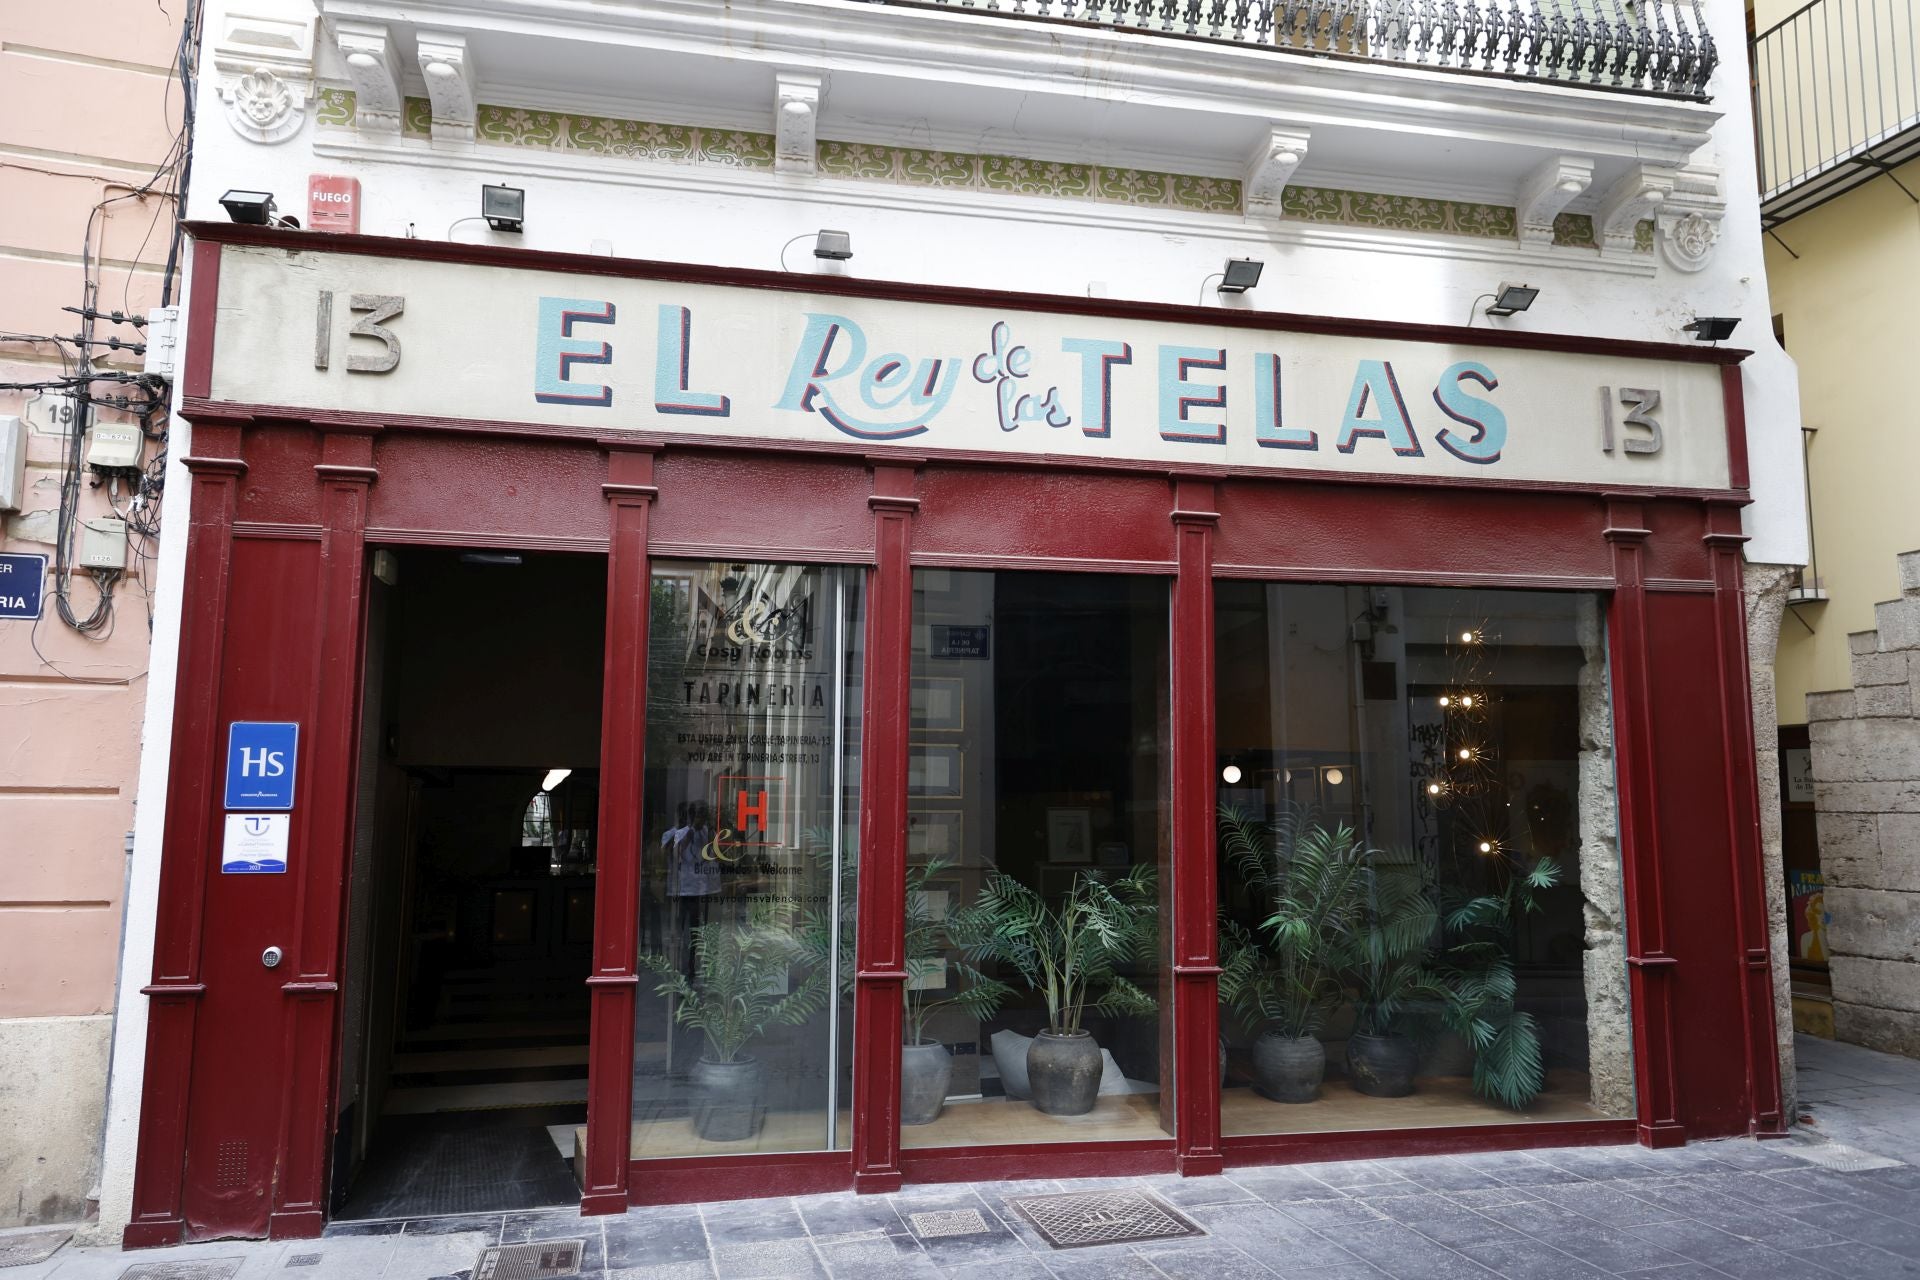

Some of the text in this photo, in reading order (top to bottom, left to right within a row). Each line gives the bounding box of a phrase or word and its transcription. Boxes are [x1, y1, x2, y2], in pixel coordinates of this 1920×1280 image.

[313, 191, 352, 204] FUEGO
[314, 290, 405, 374] 13
[534, 296, 1508, 465] EL Rey de las TELAS
[48, 404, 74, 424] 19
[1599, 384, 1664, 455] 13
[696, 643, 813, 663] Cosy Rooms
[683, 679, 824, 707] TAPINERÍA
[239, 746, 285, 778] HS
[687, 751, 706, 762] YOU
[707, 752, 723, 762] ARE
[738, 790, 768, 832] H
[760, 863, 803, 876] Welcome
